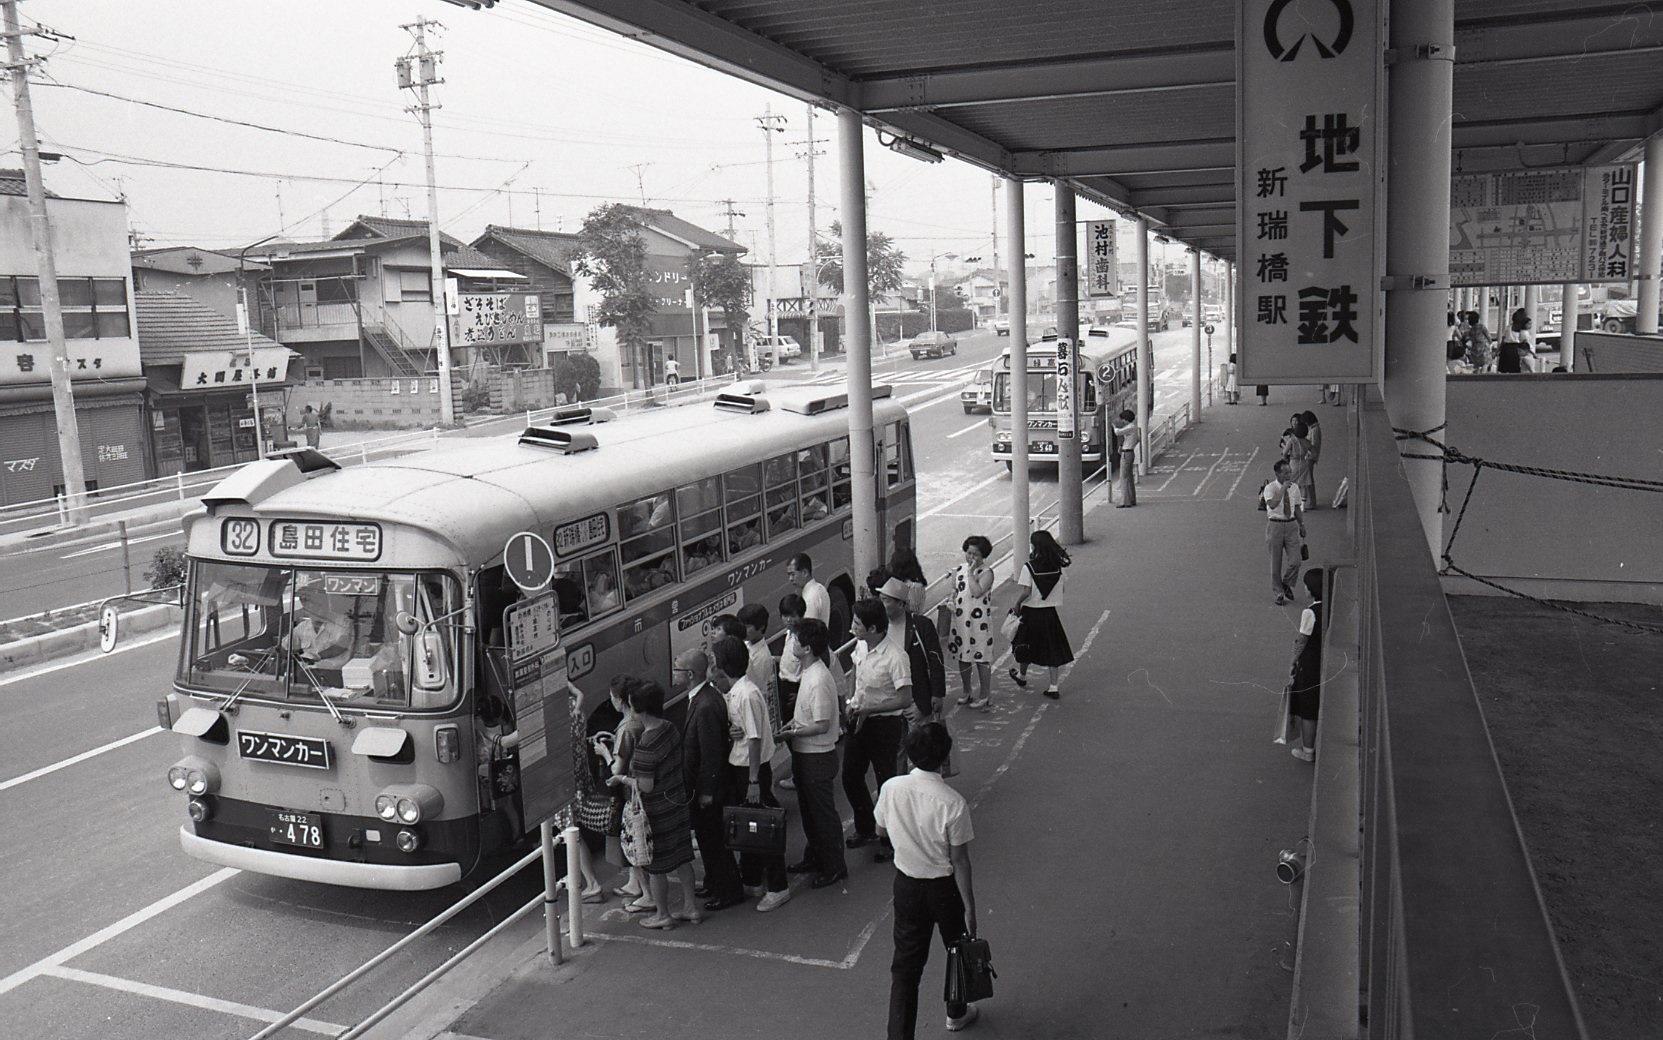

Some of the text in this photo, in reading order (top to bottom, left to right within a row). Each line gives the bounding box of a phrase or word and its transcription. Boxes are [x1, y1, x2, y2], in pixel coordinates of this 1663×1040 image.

[1298, 113, 1360, 345] 地下鉄
[1589, 217, 1598, 238] TEL
[1607, 168, 1631, 278] 山口産婦人科
[1095, 224, 1109, 290] 池村歯科
[1257, 168, 1289, 325] 新瑞橋駅
[1588, 248, 1597, 279] 7231
[464, 297, 507, 312] ざるそば
[1102, 367, 1111, 379] 2
[231, 521, 377, 555] 32 島田住宅
[326, 577, 377, 593] ワンマン
[728, 558, 772, 587] ワンマンカー
[571, 651, 592, 674] 入口
[240, 735, 323, 765] ワンマンカー
[278, 813, 307, 824] 名古屋 22
[287, 823, 321, 846] 478
